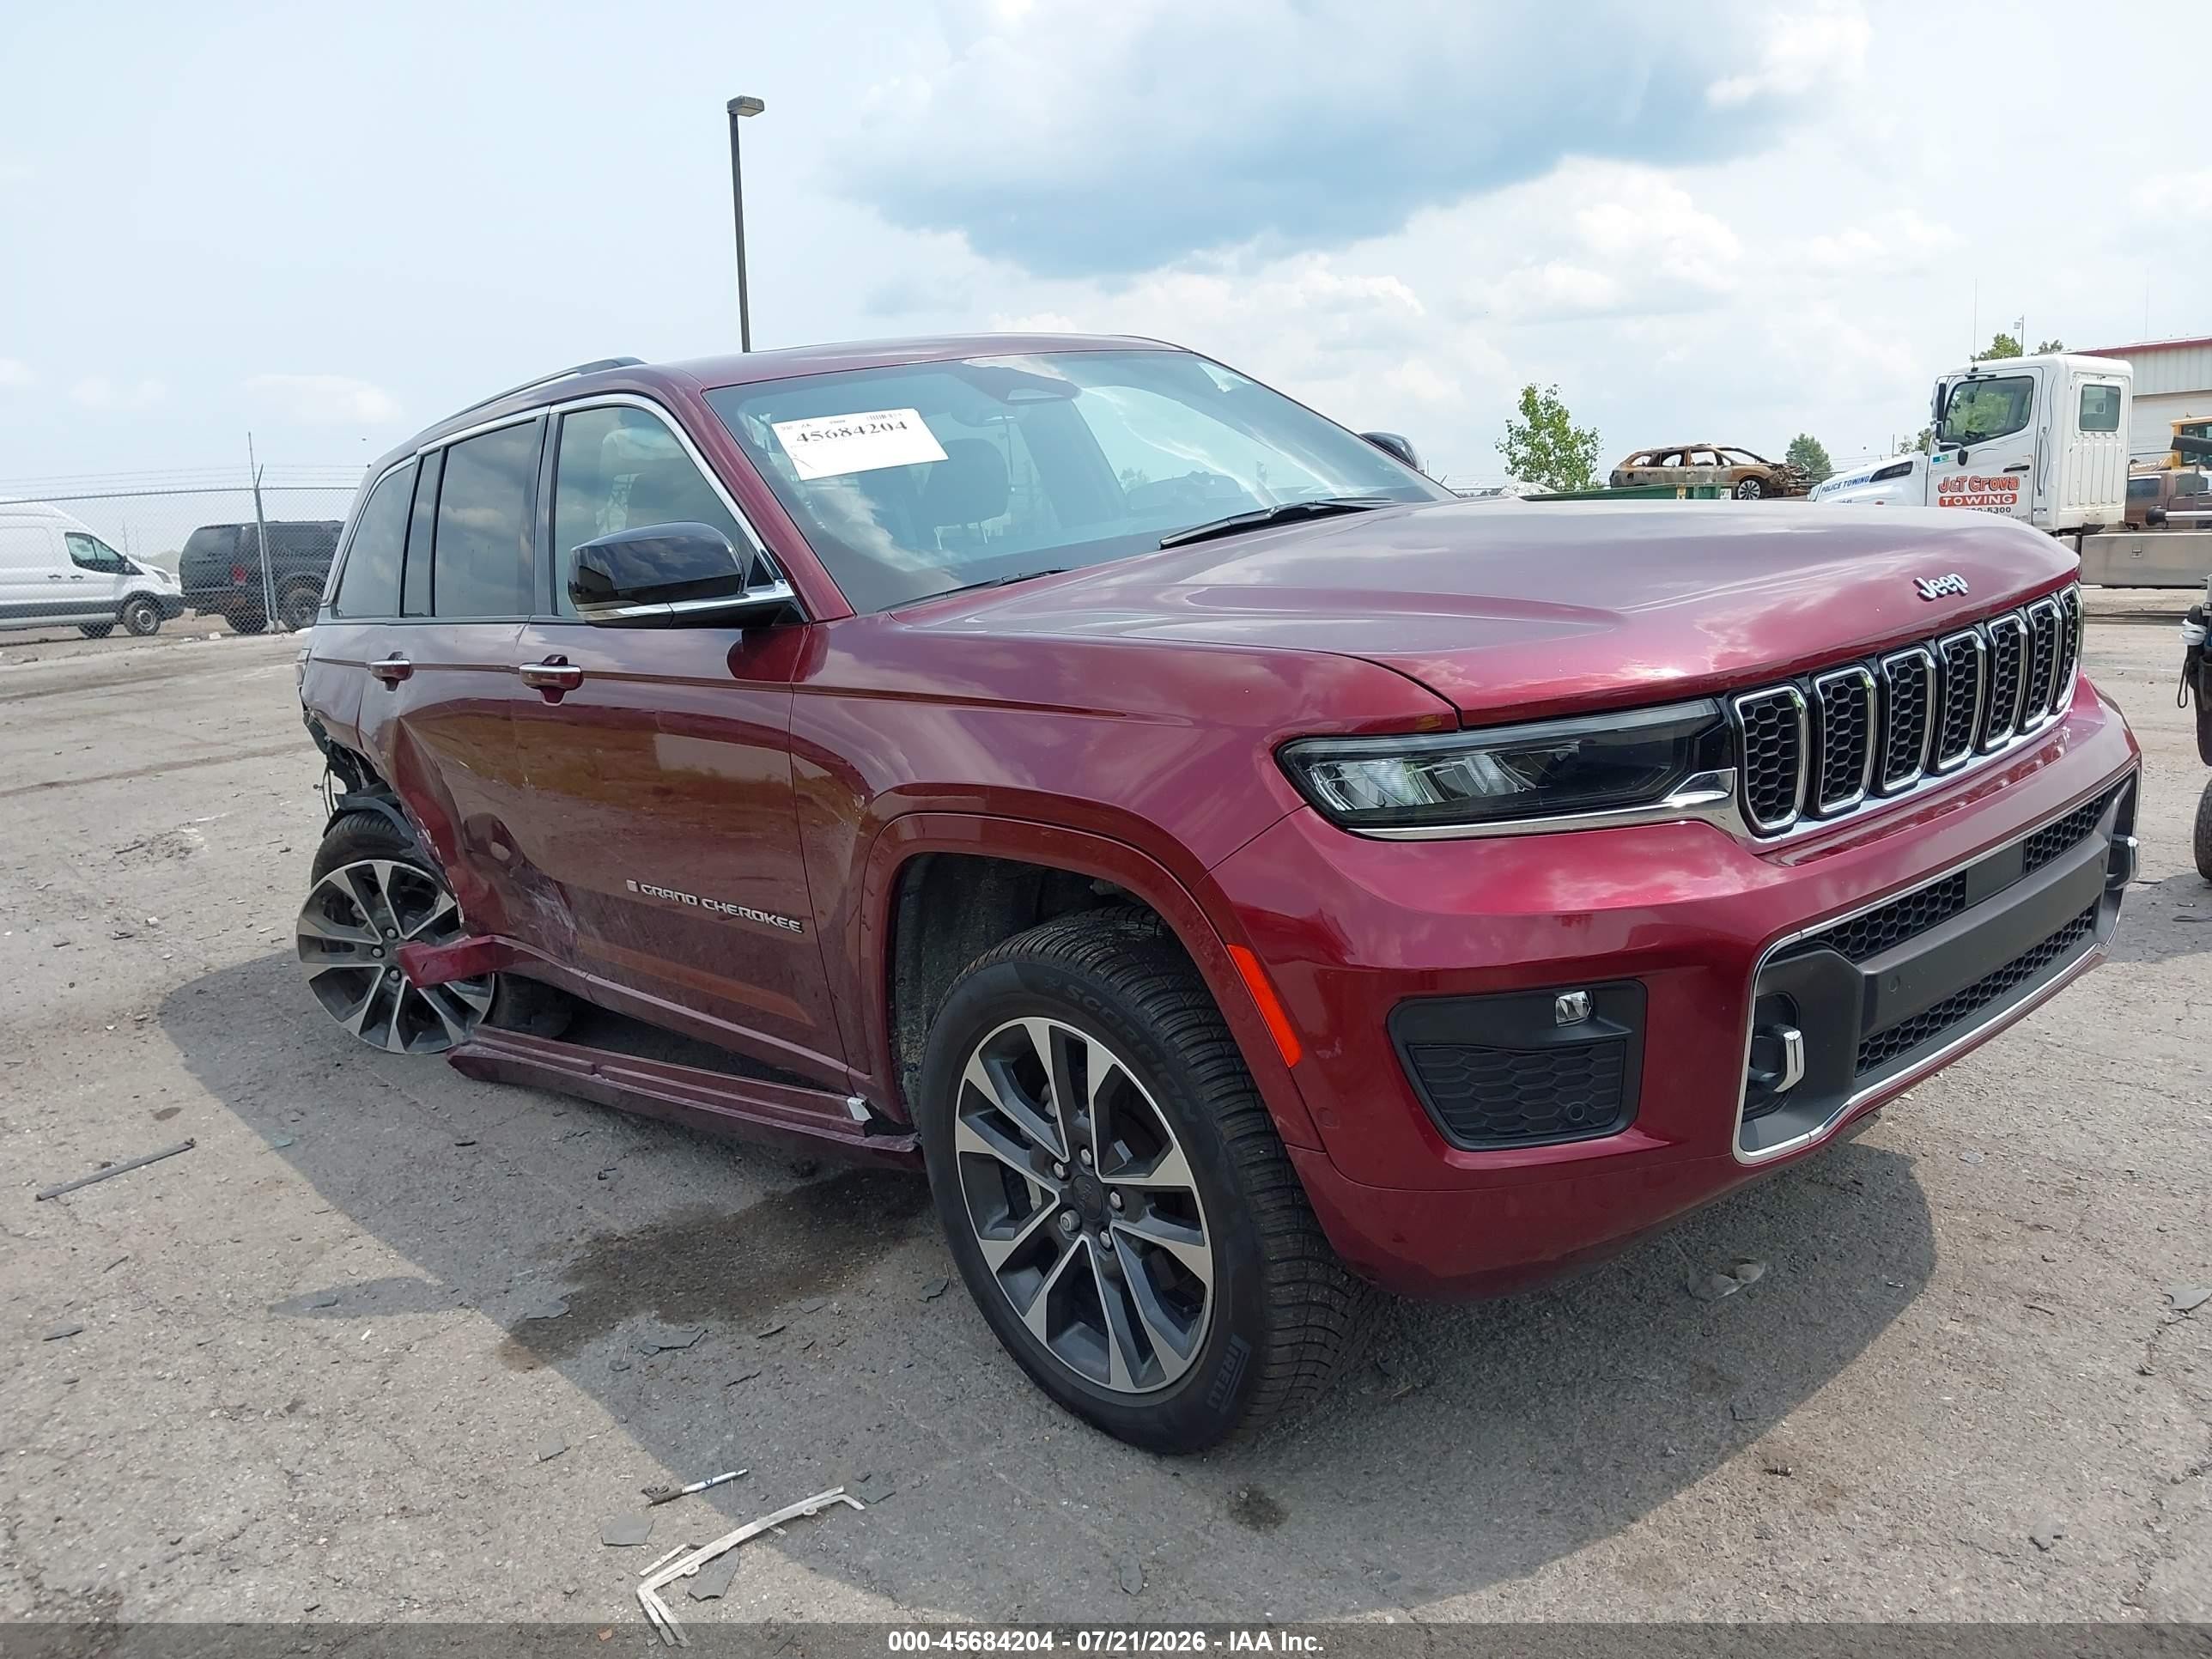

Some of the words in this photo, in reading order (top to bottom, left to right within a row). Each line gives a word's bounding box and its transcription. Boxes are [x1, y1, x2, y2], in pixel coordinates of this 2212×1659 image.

[796, 421, 908, 442] 45684204
[1820, 481, 1842, 495] POLICE
[1843, 475, 1870, 489] TOWING
[1968, 476, 2020, 492] Crova
[1942, 494, 2014, 506] TOWING
[1913, 573, 1969, 601] Jeep
[641, 884, 698, 906] GRAND
[702, 898, 803, 933] CHEROKEE
